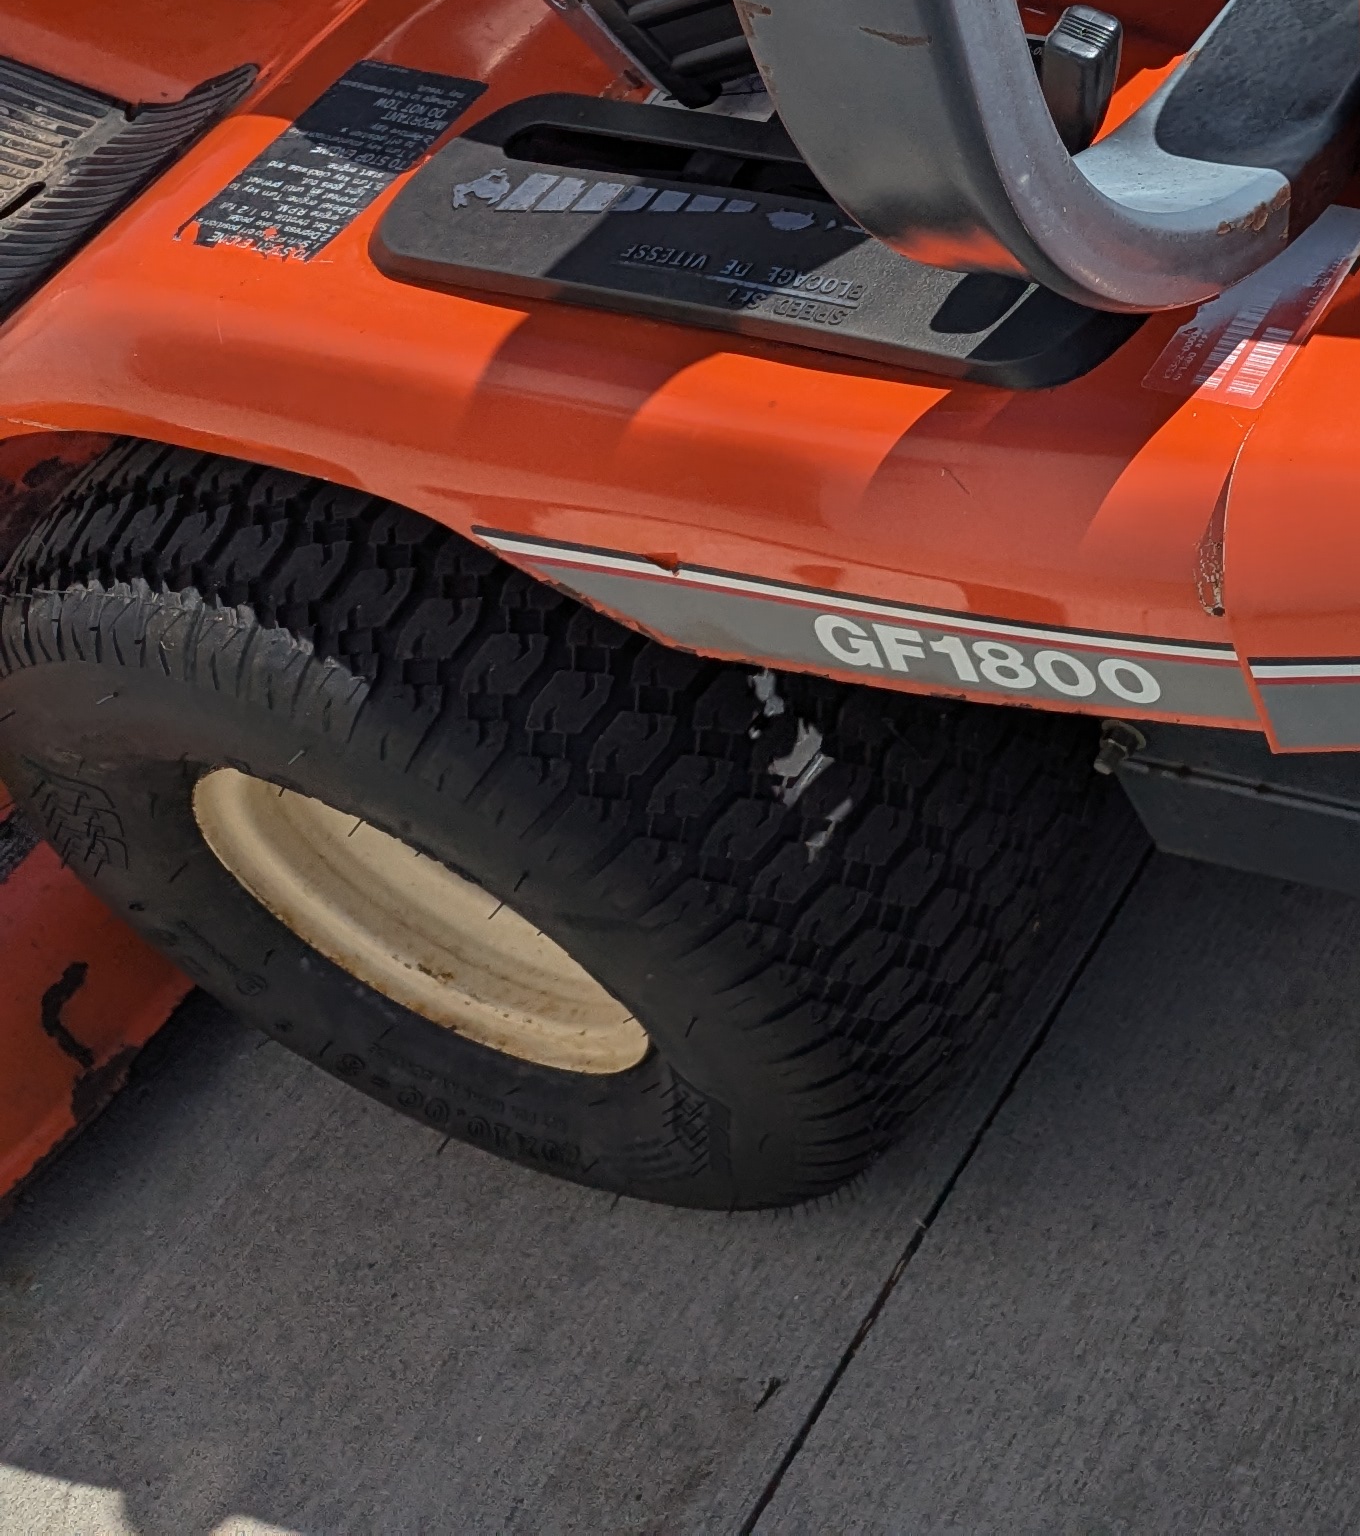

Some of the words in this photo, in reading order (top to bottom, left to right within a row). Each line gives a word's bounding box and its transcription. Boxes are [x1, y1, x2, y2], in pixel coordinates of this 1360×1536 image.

[370, 96, 405, 110] TOW
[398, 101, 431, 115] NOT
[424, 106, 449, 118] DO
[376, 110, 450, 131] IMPORTANT
[306, 141, 359, 160] ENGINE
[352, 151, 391, 166] STOP
[257, 189, 285, 200] Turn
[719, 259, 755, 277] DE
[767, 266, 869, 301] BLOCAGE
[772, 298, 850, 326] SPEED
[812, 613, 1163, 706] GF1800
